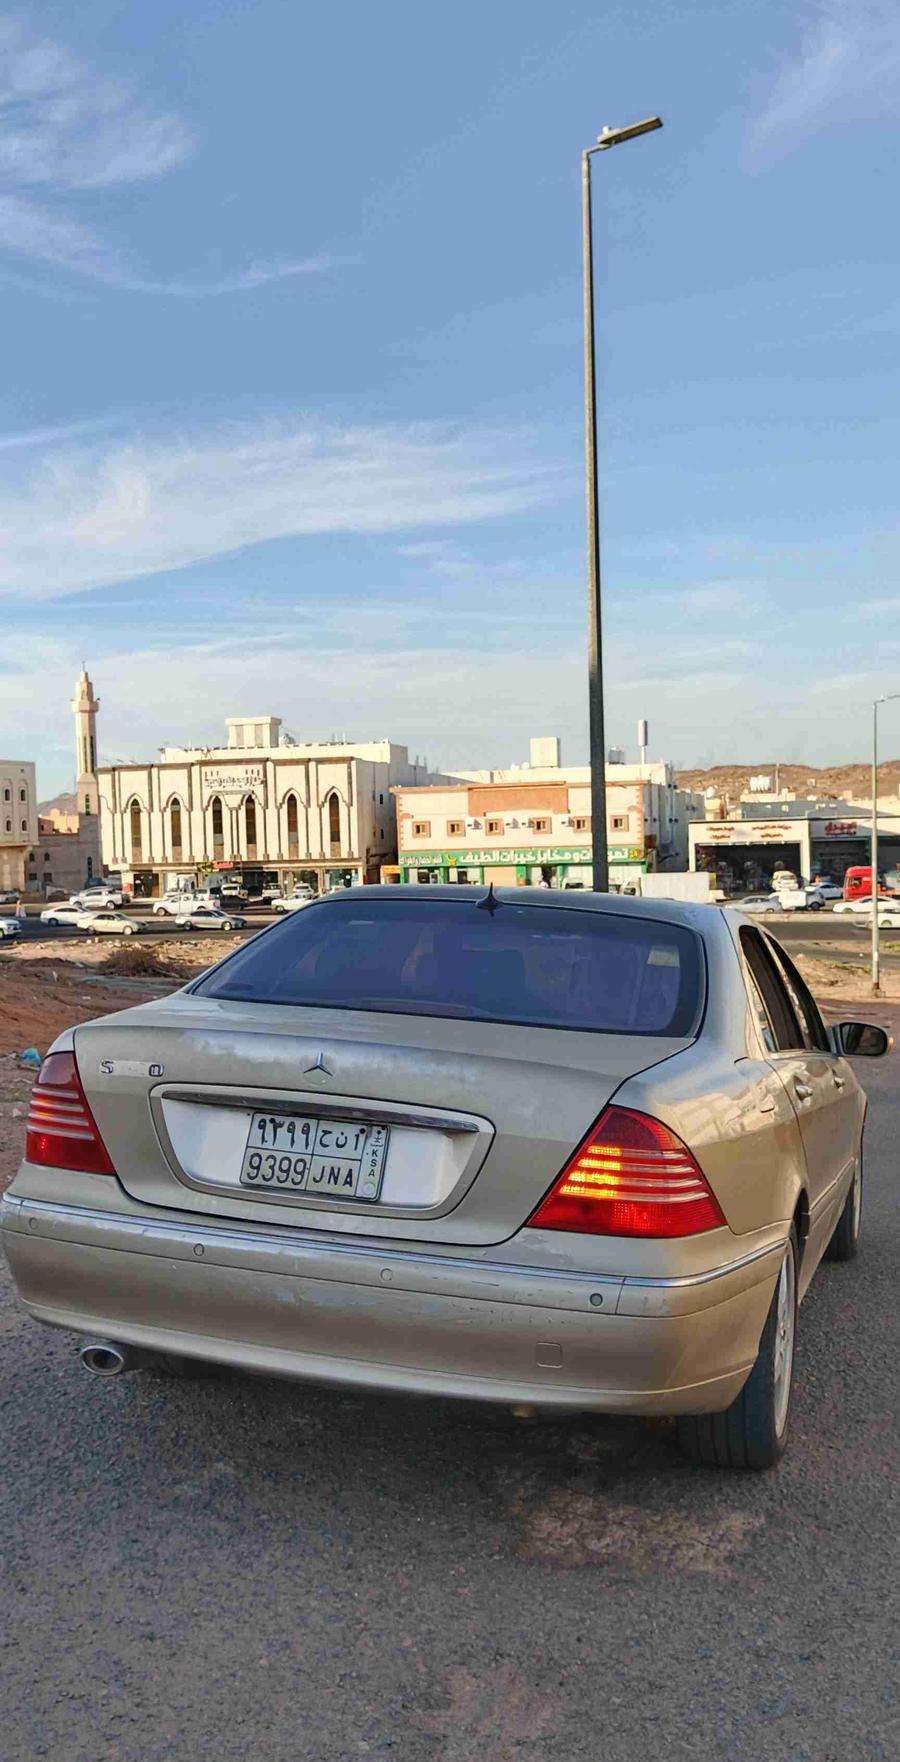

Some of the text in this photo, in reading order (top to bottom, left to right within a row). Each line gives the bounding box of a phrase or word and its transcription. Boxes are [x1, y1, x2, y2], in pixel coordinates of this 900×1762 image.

[460, 850, 500, 866] الطيف
[247, 1152, 353, 1187] 9399 JNA
[368, 1148, 378, 1177] KSA
